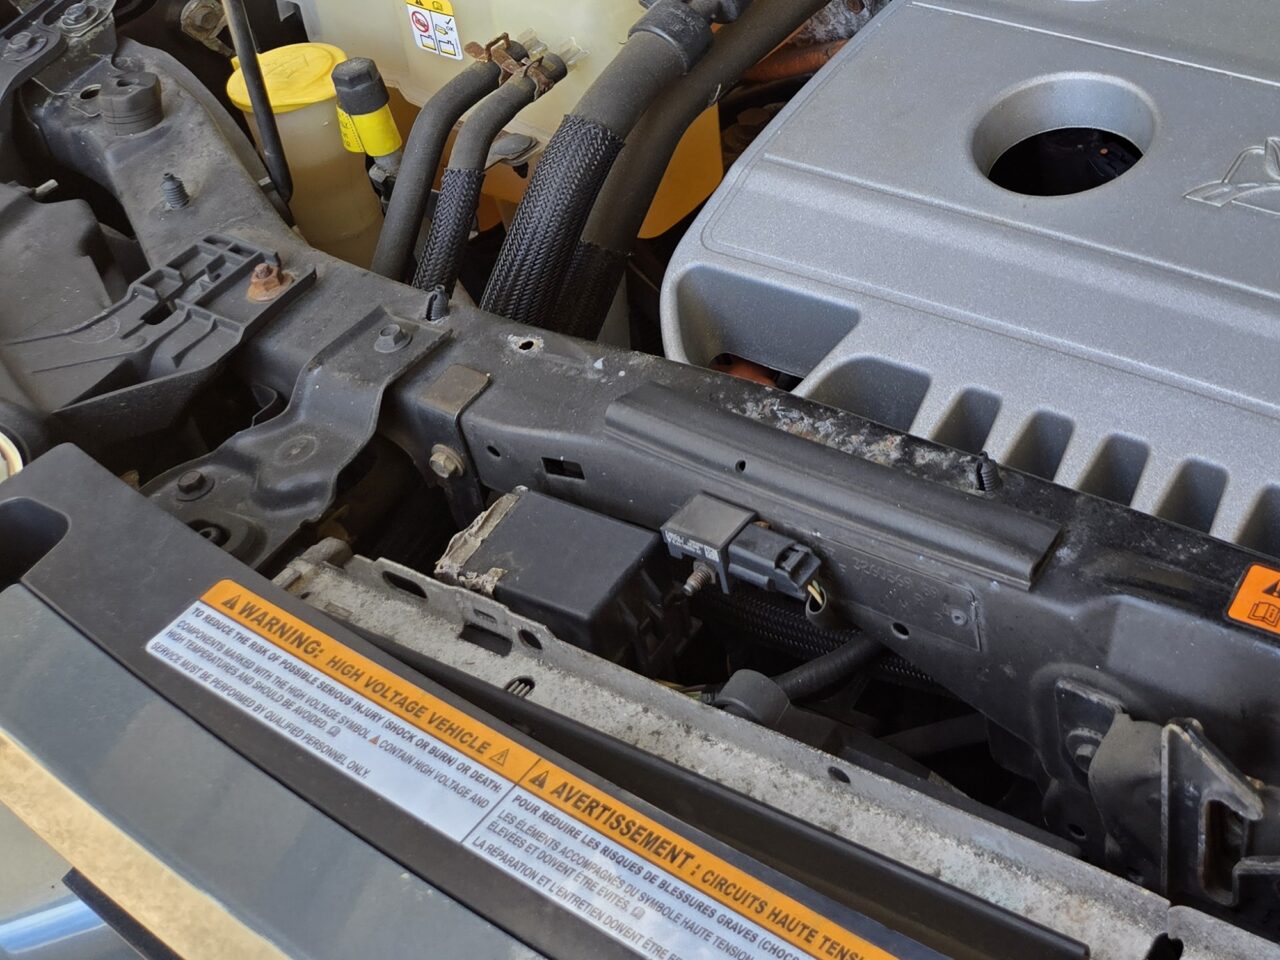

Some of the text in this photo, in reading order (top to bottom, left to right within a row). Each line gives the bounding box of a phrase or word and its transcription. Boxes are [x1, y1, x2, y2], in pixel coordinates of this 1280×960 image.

[151, 641, 182, 664] SERVICE
[180, 659, 204, 676] MUST
[200, 671, 214, 683] BE
[209, 676, 257, 708] PERFORMED
[252, 702, 269, 715] BY
[264, 710, 305, 738] QUALIFIED
[301, 732, 348, 766] PERSONNEL
[166, 629, 328, 731] HIGH TEMPERATURES AND SHOULD BE AVOIDED.
[176, 620, 491, 809] COMPONENTS MARKED WITH THE HIGH VOLTAGE SYMBOL CONTAIN HIGH VOLTAGE AND
[191, 607, 503, 793] TO REDUCE THE RISK OF POSSIBLE SERIOUS INJURY (SHOCK OR BURN) OR DEATH:
[238, 601, 492, 755] WARNING: HIGH VOLTAGE VEHICLE
[472, 836, 486, 851] LA
[484, 841, 541, 882] RÉPARATION
[536, 875, 555, 888] ET
[549, 881, 606, 921] L'ENTRETIEN
[603, 914, 646, 945] DOIVENT
[486, 819, 528, 850] ÉLEVÉES
[523, 844, 541, 856] ET
[536, 850, 577, 878] DOIVENT
[573, 869, 601, 892] ÊTRE
[497, 809, 517, 825] LES
[514, 818, 562, 852] ÉLÉMENTS
[559, 844, 627, 889] ACCOMPAGNÉS
[623, 883, 641, 898] DU
[637, 891, 683, 924] SYMBOLE
[680, 917, 714, 942] HAUTE
[512, 794, 543, 816] POUR
[539, 808, 583, 840] RÉDUIRE
[581, 834, 602, 851] LES
[599, 845, 645, 876] RISQUES
[642, 870, 660, 885] DE
[657, 879, 718, 919] BLESSURES
[716, 913, 759, 943] GRAVES
[550, 781, 695, 870] AVERTISSEMENT
[701, 869, 768, 915] CIRCUITS
[766, 906, 819, 944] HAUTE
[818, 934, 864, 960] TENS
